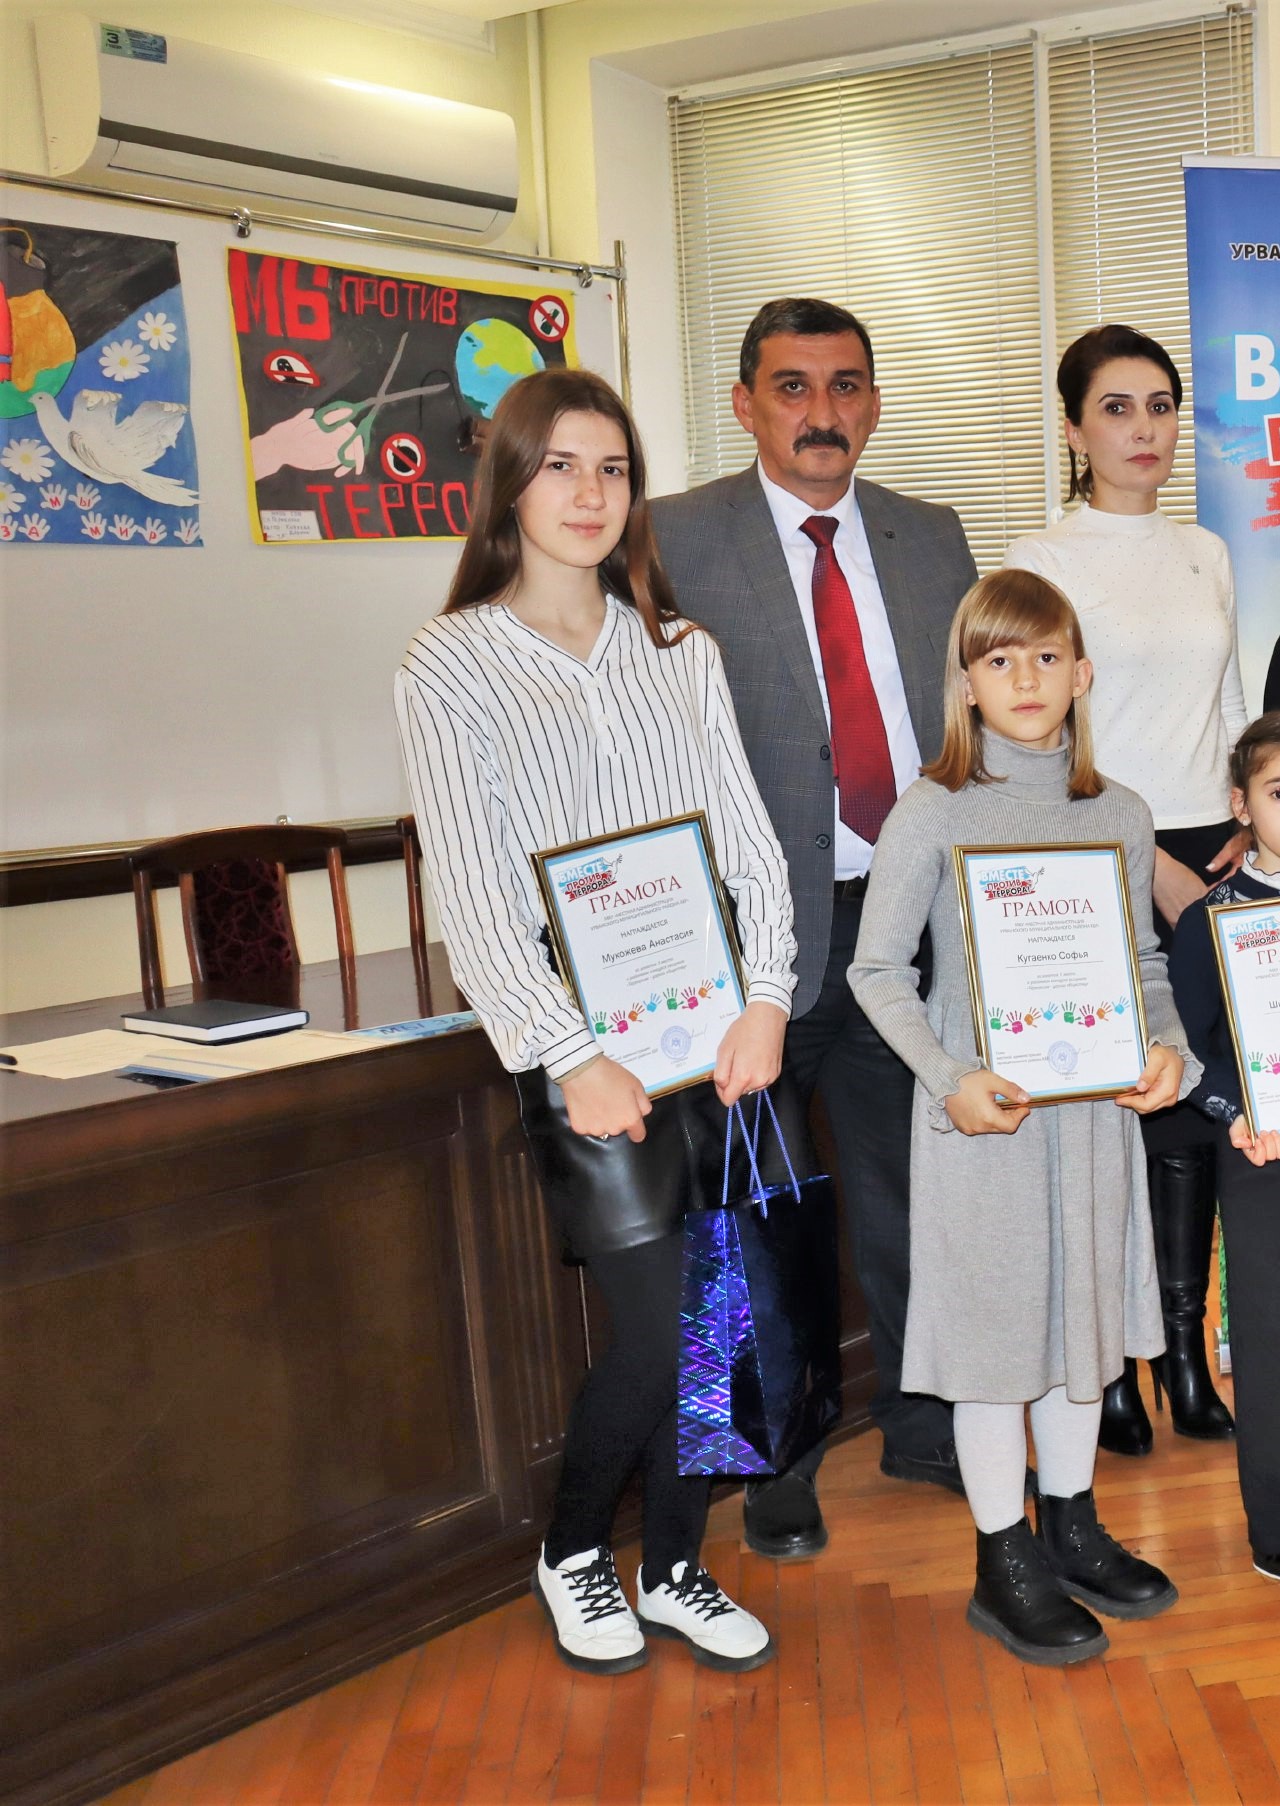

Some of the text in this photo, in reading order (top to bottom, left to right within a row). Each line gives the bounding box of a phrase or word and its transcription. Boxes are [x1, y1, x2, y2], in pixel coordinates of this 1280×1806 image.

[106, 32, 119, 44] 3
[340, 276, 458, 326] ПРОТИВ
[48, 496, 91, 508] МЫ
[306, 482, 475, 540] ТЕРРО
[0, 525, 40, 538] ЗА
[558, 862, 605, 881] ВМЕСТЕ
[982, 869, 1025, 883] ВМЕСТЕ
[566, 872, 601, 891] ПРОТИВ
[573, 876, 612, 897] ТЕРРОРА!
[987, 879, 1021, 891] ПРОТИВ
[588, 875, 683, 915] ГРАМОТА
[992, 886, 1030, 898] ТЕРРОРА!
[1002, 898, 1095, 918] ГРАМОТА
[620, 919, 669, 939] НАГРАЖДАЕТСЯ
[1230, 920, 1273, 934] ВМЕСТЕ
[1027, 934, 1076, 943] НАГРАЖДАЕТСЯ
[1236, 929, 1270, 942] ПРОТИВ
[1242, 935, 1280, 949] ТЕРРОРА!
[602, 929, 694, 964] Мукожева Анастасия
[1058, 951, 1089, 960] Софья
